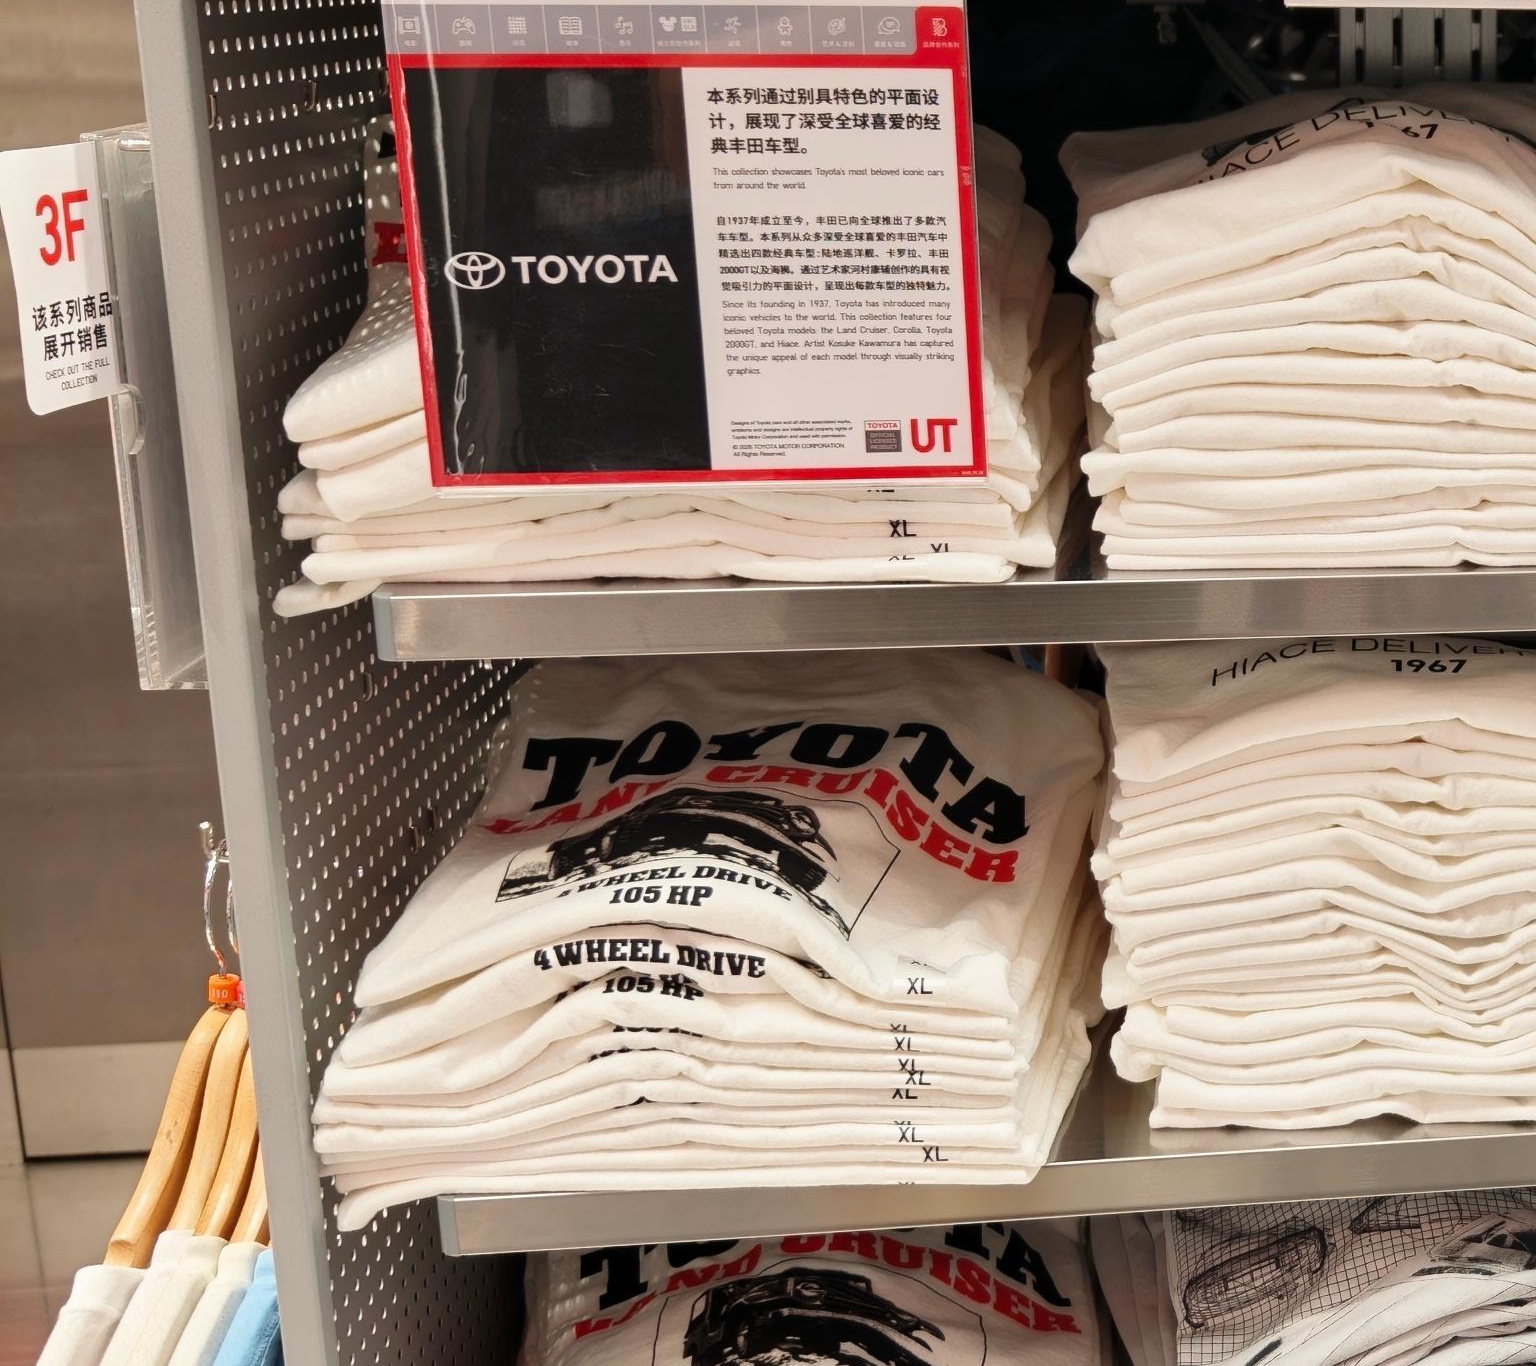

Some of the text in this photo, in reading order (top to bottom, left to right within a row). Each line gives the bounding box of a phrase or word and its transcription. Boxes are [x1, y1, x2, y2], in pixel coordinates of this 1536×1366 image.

[706, 87, 940, 106] 本系列通过别具特色的平面设
[708, 112, 942, 131] 计，展现了深受全球喜爱的经
[710, 137, 808, 156] 典丰田车型。
[731, 167, 925, 178] collection showcases Toyota's beloved iconic
[736, 181, 764, 189] around
[35, 188, 88, 266] 3F
[511, 254, 678, 284] TOYOTA
[32, 291, 113, 332] 该系列商品
[722, 299, 926, 310] Since founding Toyota introduced
[723, 313, 933, 321] iconic vehicles collection features
[724, 326, 953, 336] beloved Toyota Toyota
[43, 324, 108, 362] 展开销售
[803, 340, 954, 350] Artist Kosuke Kawamura captured
[742, 353, 955, 363] unique appeal model through visually striking
[45, 367, 65, 381] CHECK
[66, 364, 80, 376] OUT
[60, 374, 98, 391] COLLECTION
[866, 422, 899, 430] TOYOTA
[910, 418, 958, 453] UT
[889, 519, 917, 538] XL
[1211, 637, 1336, 688] HIACE
[1390, 658, 1468, 676] 1967
[522, 720, 1031, 844] TOYOTA
[704, 763, 1019, 886] CRUISER
[694, 863, 793, 903] DRIVE
[608, 886, 714, 908] 105 HP
[532, 938, 768, 980] 4 WHEEL DRIVE
[601, 975, 656, 997] 105
[906, 977, 933, 995] XL
[894, 1036, 920, 1052] XL
[898, 1127, 924, 1143] XL
[922, 1146, 949, 1162] XL
[777, 1231, 1082, 1335] CRUISER
